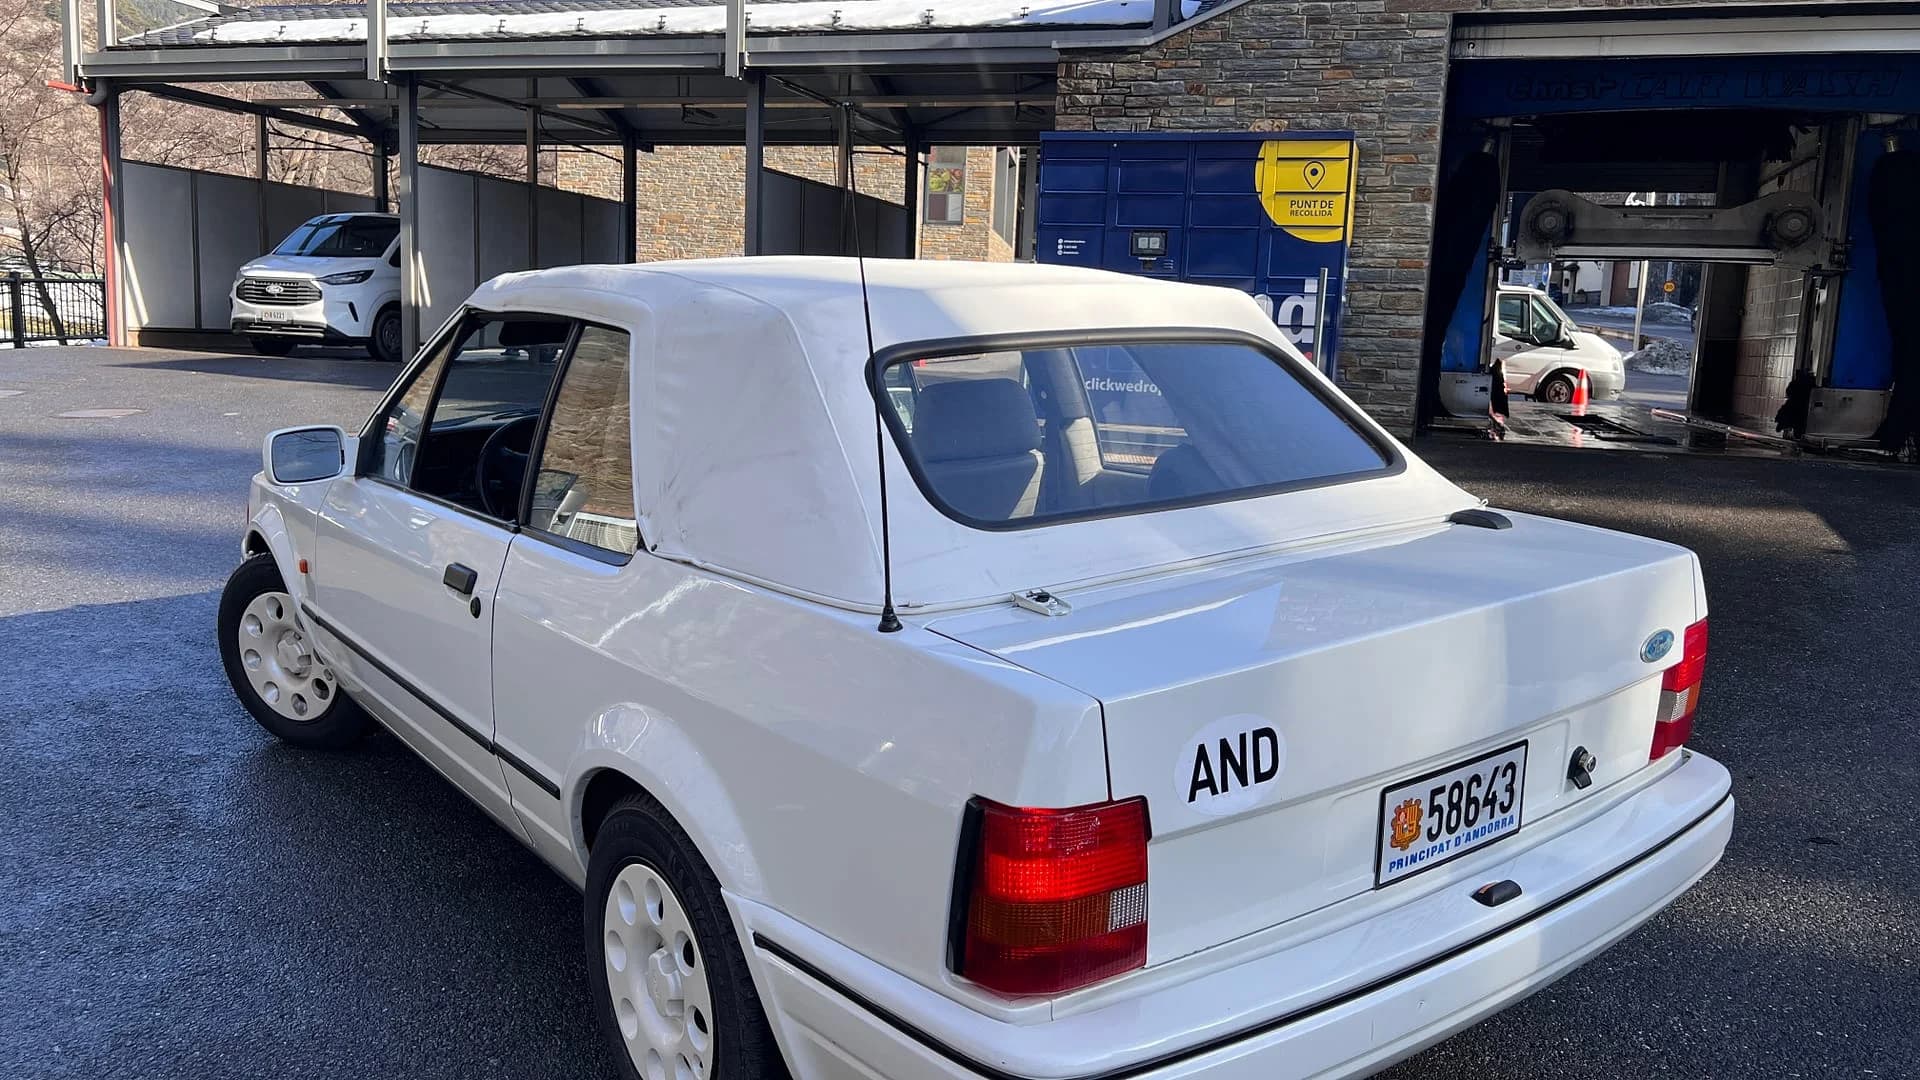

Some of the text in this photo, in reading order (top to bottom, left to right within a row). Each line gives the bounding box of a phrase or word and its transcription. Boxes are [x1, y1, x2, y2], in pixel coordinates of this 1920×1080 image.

[1622, 71, 1730, 99] CAR
[1744, 69, 1905, 98] WASH
[1289, 209, 1333, 217] RECOLLIDA
[1290, 199, 1335, 209] PUNT DE
[1085, 377, 1163, 397] clickwedro
[1187, 726, 1279, 803] AND
[1426, 761, 1517, 842] 58643
[1388, 814, 1515, 872] PRINCIPAT D'ANDORRA
